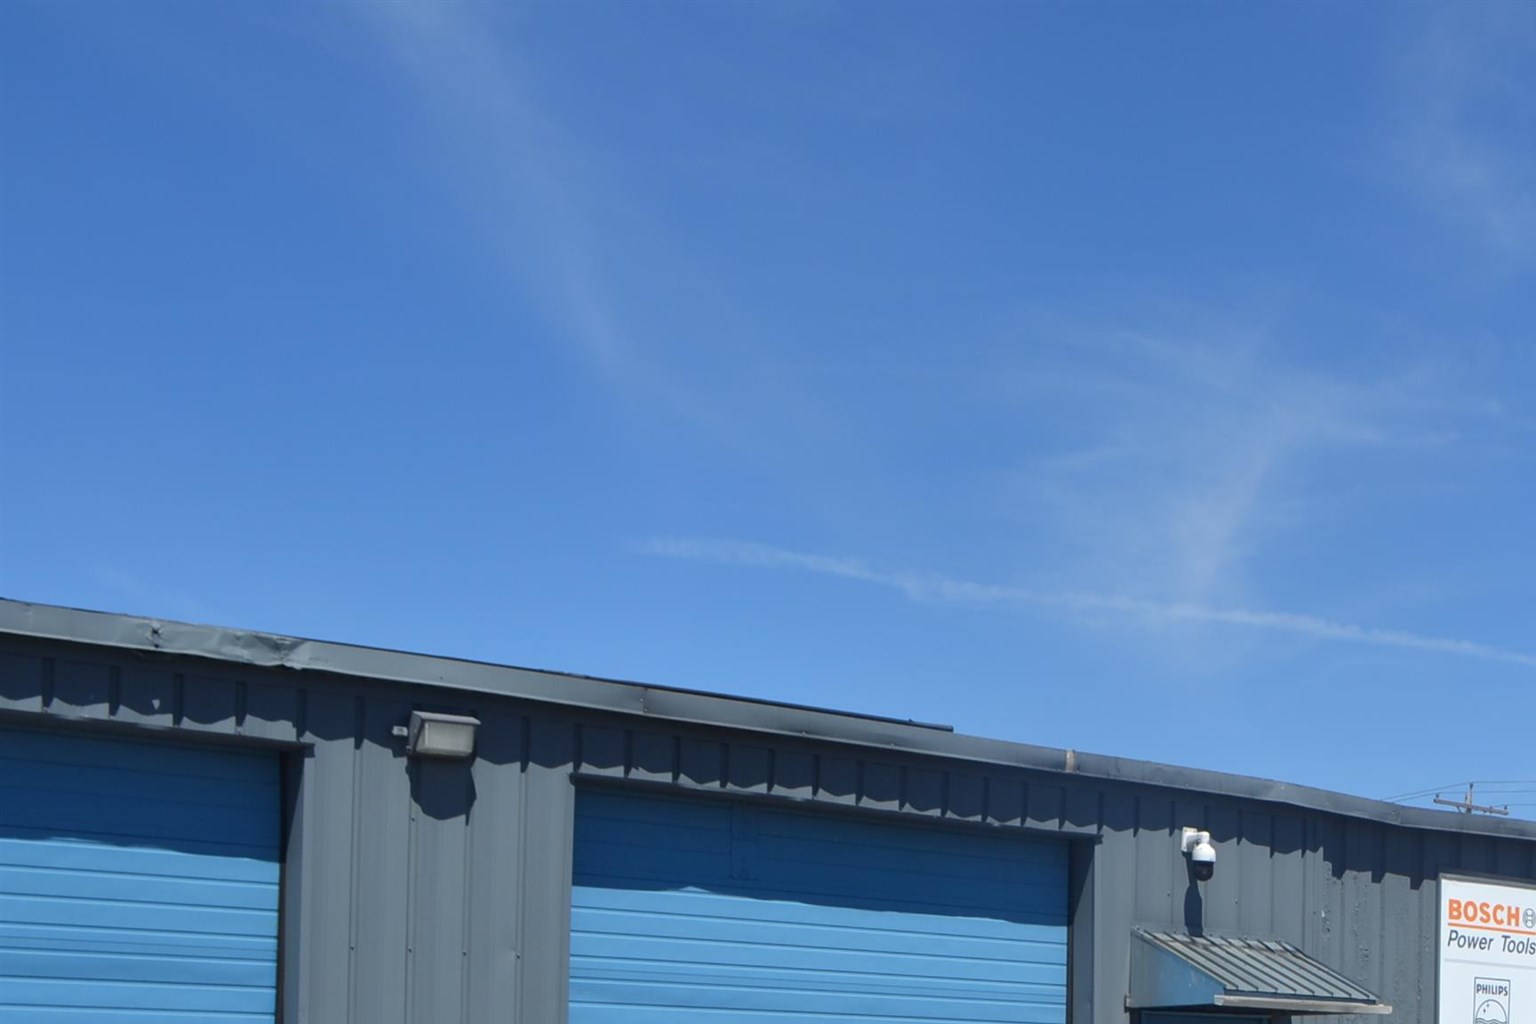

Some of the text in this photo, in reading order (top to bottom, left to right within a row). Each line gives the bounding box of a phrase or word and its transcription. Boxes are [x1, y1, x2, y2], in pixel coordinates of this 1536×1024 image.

[1448, 898, 1520, 927] BOSCH
[1447, 929, 1536, 955] Power Tools
[1476, 983, 1508, 996] PHILIPS
